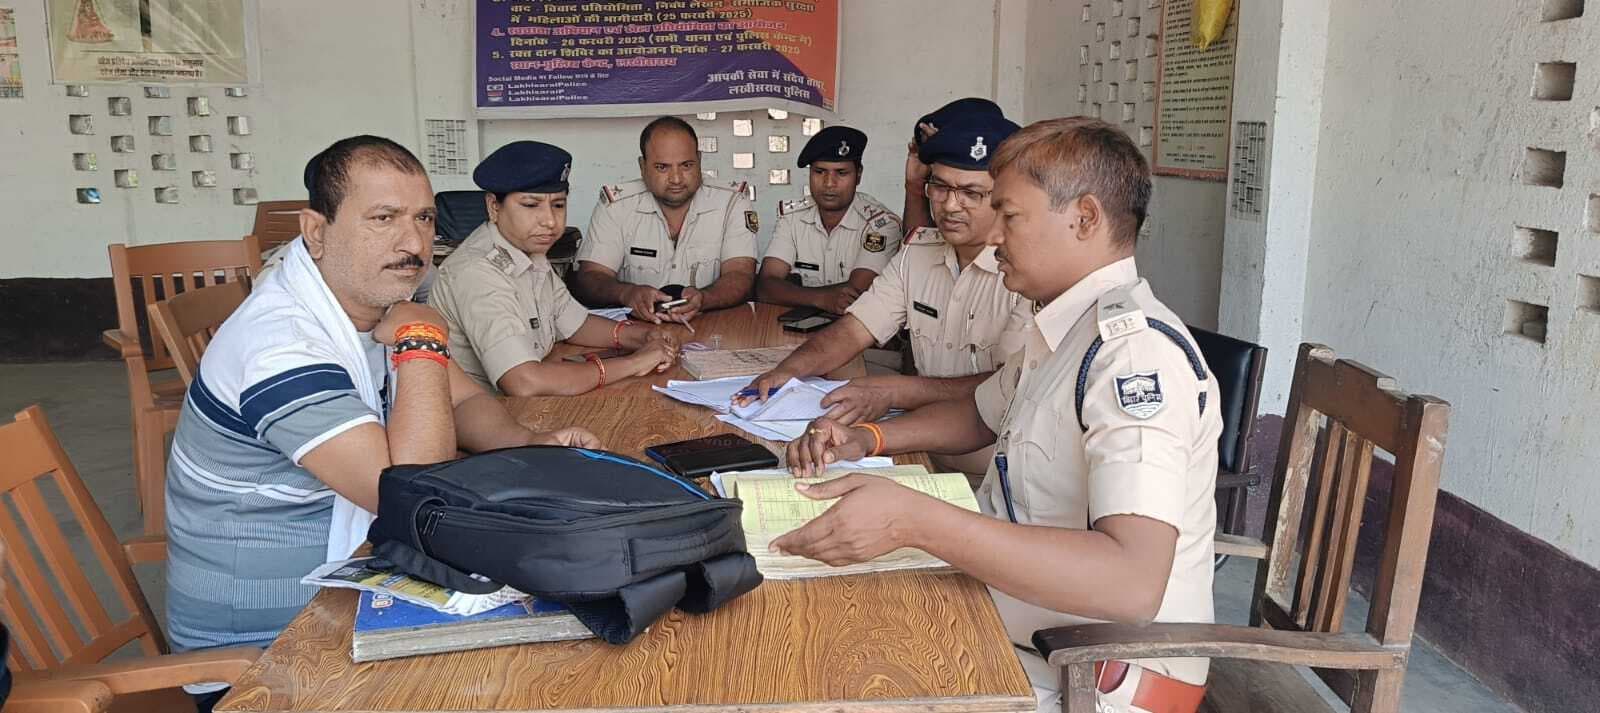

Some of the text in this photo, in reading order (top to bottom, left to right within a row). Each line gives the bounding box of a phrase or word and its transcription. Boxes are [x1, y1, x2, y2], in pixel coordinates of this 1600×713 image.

[511, 4, 531, 13] वाद
[544, 4, 577, 13] विवाद
[528, 14, 581, 24] महिलाओं
[584, 13, 600, 23] की
[604, 13, 653, 23] भागीदारी
[535, 48, 557, 58] दान
[707, 71, 745, 83] आपकी
[748, 69, 769, 80] सेवा
[771, 70, 781, 80] में
[728, 83, 810, 99] लखीसराय पुलिस
